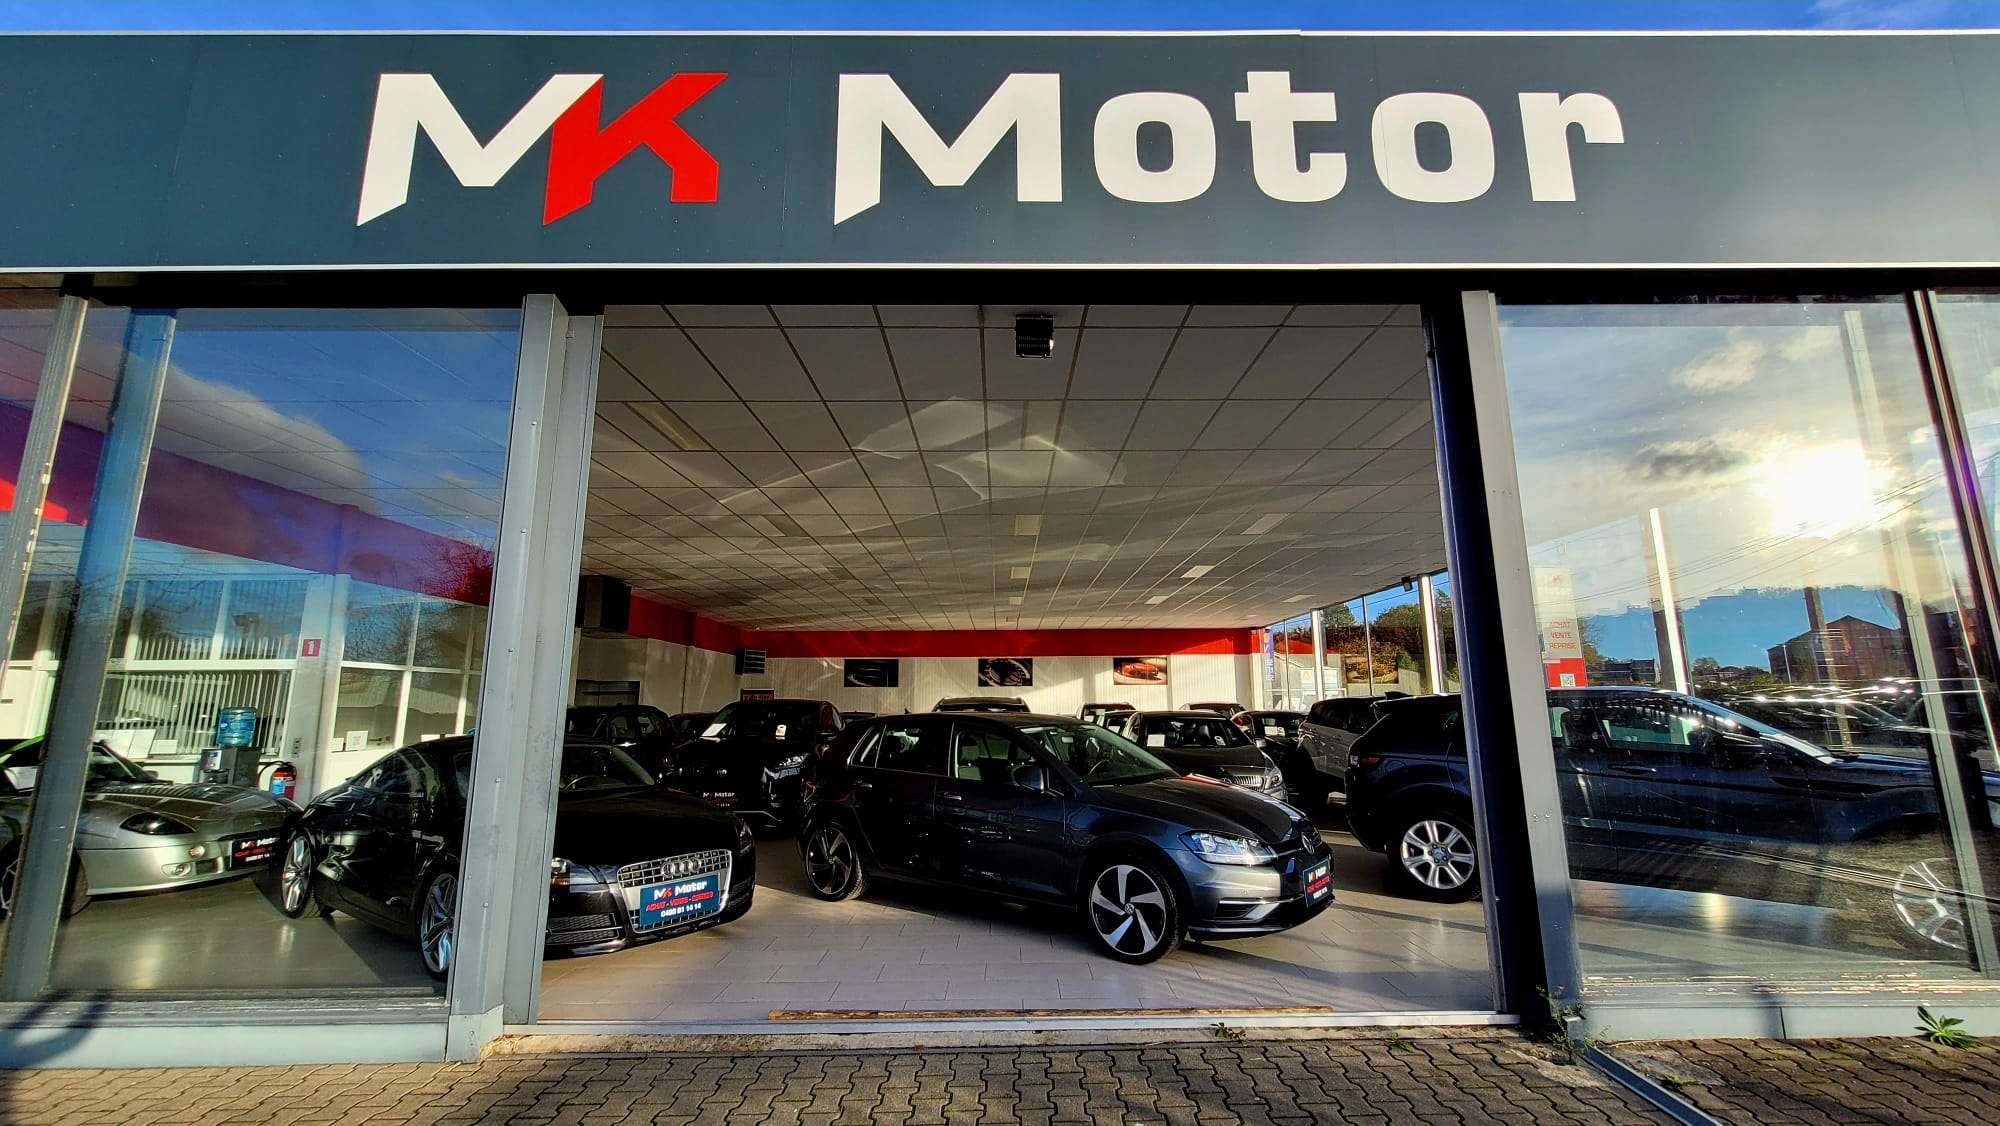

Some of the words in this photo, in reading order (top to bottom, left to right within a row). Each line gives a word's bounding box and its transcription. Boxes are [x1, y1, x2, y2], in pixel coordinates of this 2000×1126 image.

[356, 72, 729, 226] MK
[833, 70, 1626, 226] Motor
[675, 881, 707, 896] Motor
